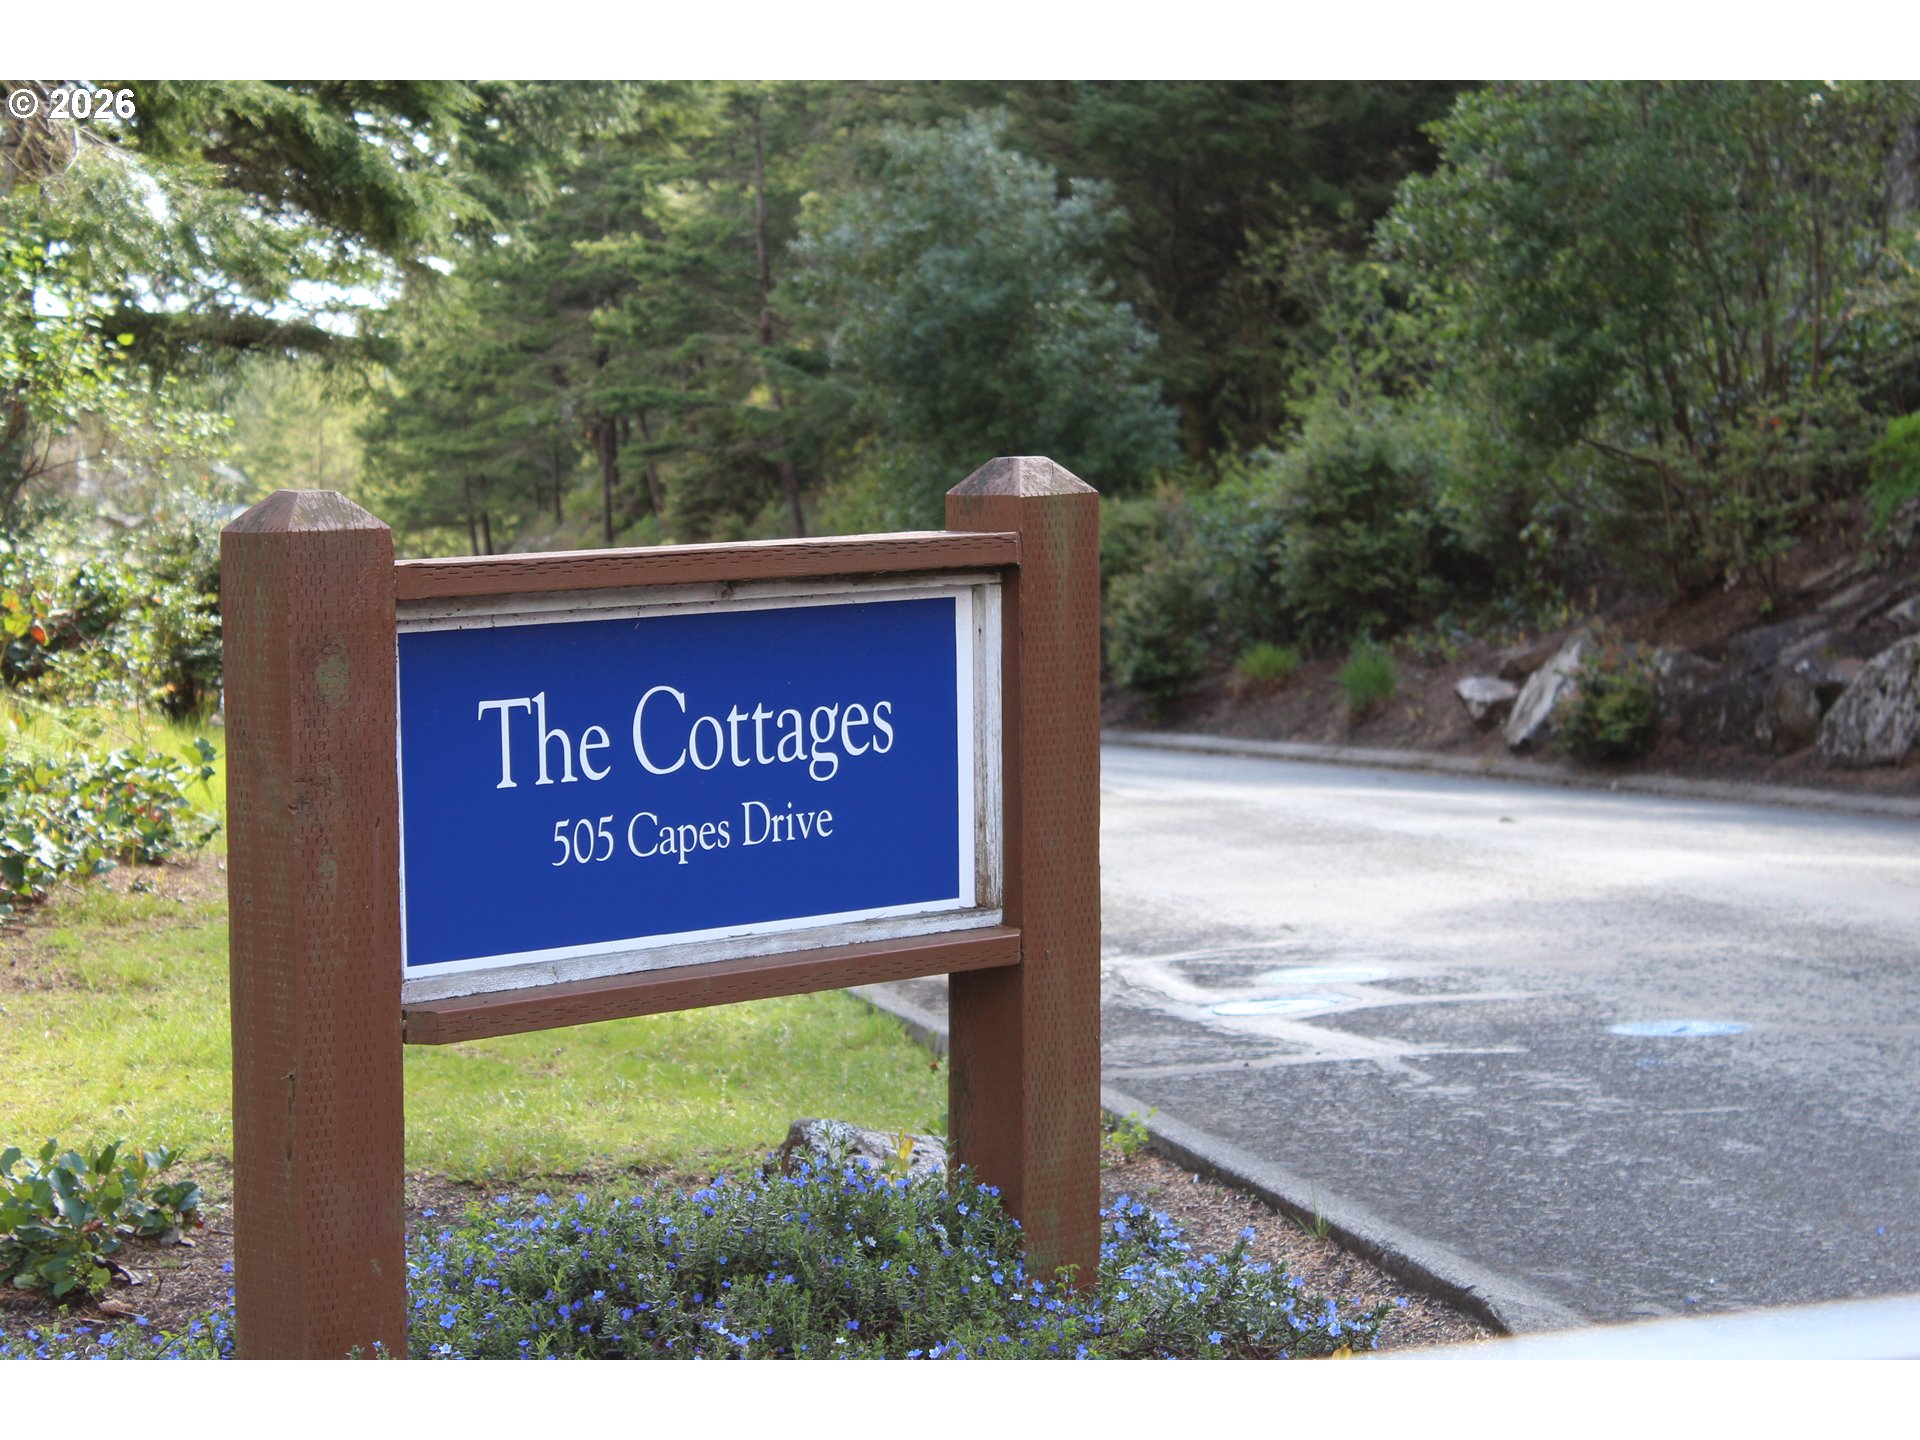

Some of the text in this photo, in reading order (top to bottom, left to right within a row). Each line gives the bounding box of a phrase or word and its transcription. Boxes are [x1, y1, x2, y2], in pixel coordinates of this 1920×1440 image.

[477, 685, 894, 789] The Cottages
[552, 800, 833, 867] 505 Capes Drive
